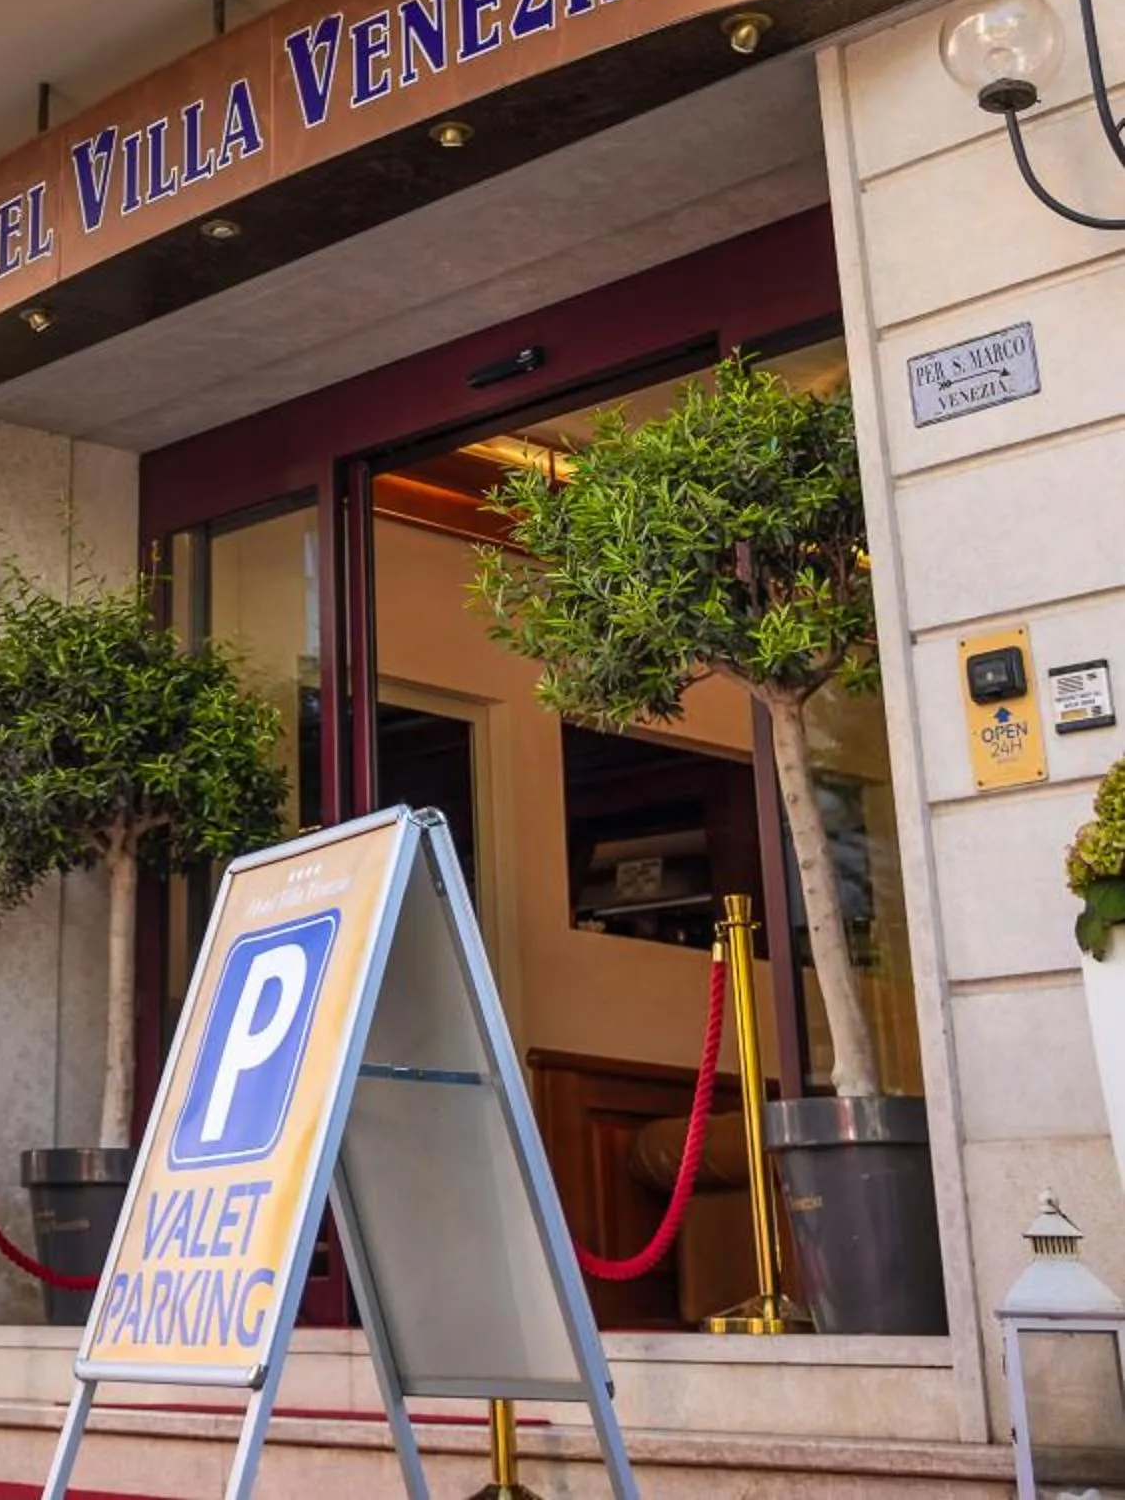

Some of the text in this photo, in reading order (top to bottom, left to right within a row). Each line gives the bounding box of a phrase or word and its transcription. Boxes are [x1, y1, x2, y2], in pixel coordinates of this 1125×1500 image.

[916, 361, 946, 387] PER
[969, 336, 1027, 371] MARCO
[938, 378, 1012, 410] VENEZIA
[982, 723, 1028, 743] OPEN
[991, 738, 1023, 758] 24H
[200, 943, 308, 1142] P
[141, 1180, 273, 1261] VALET
[96, 1268, 275, 1348] PARKING
